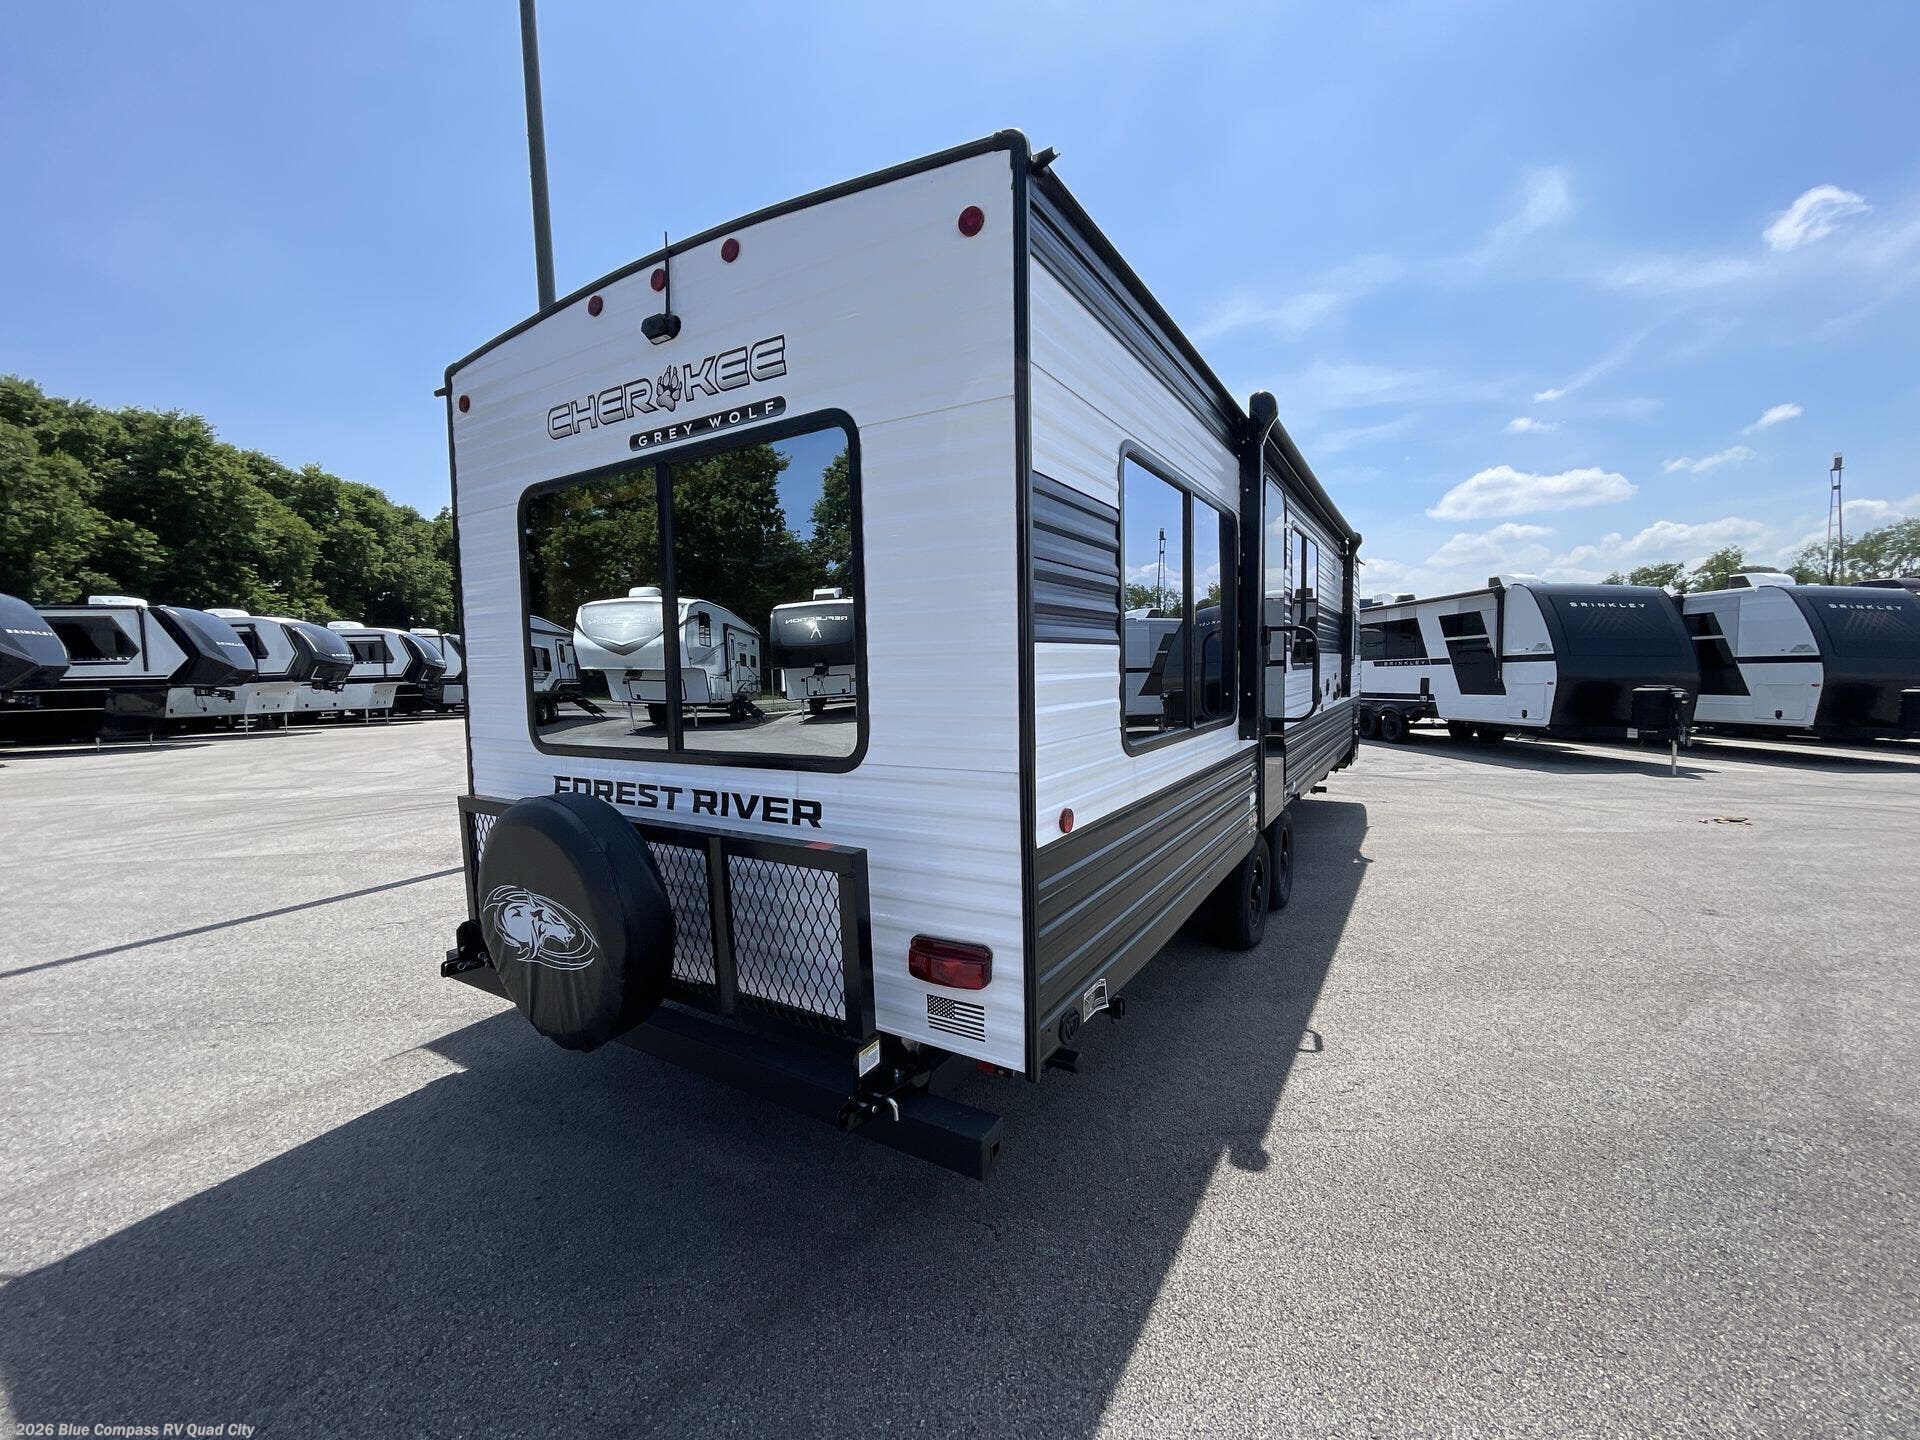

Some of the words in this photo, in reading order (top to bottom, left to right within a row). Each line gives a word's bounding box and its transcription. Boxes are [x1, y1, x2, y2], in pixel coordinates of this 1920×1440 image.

[637, 424, 693, 448] GREY
[709, 401, 776, 429] WOLF
[553, 775, 683, 811] FOREST
[691, 788, 823, 829] RIVER
